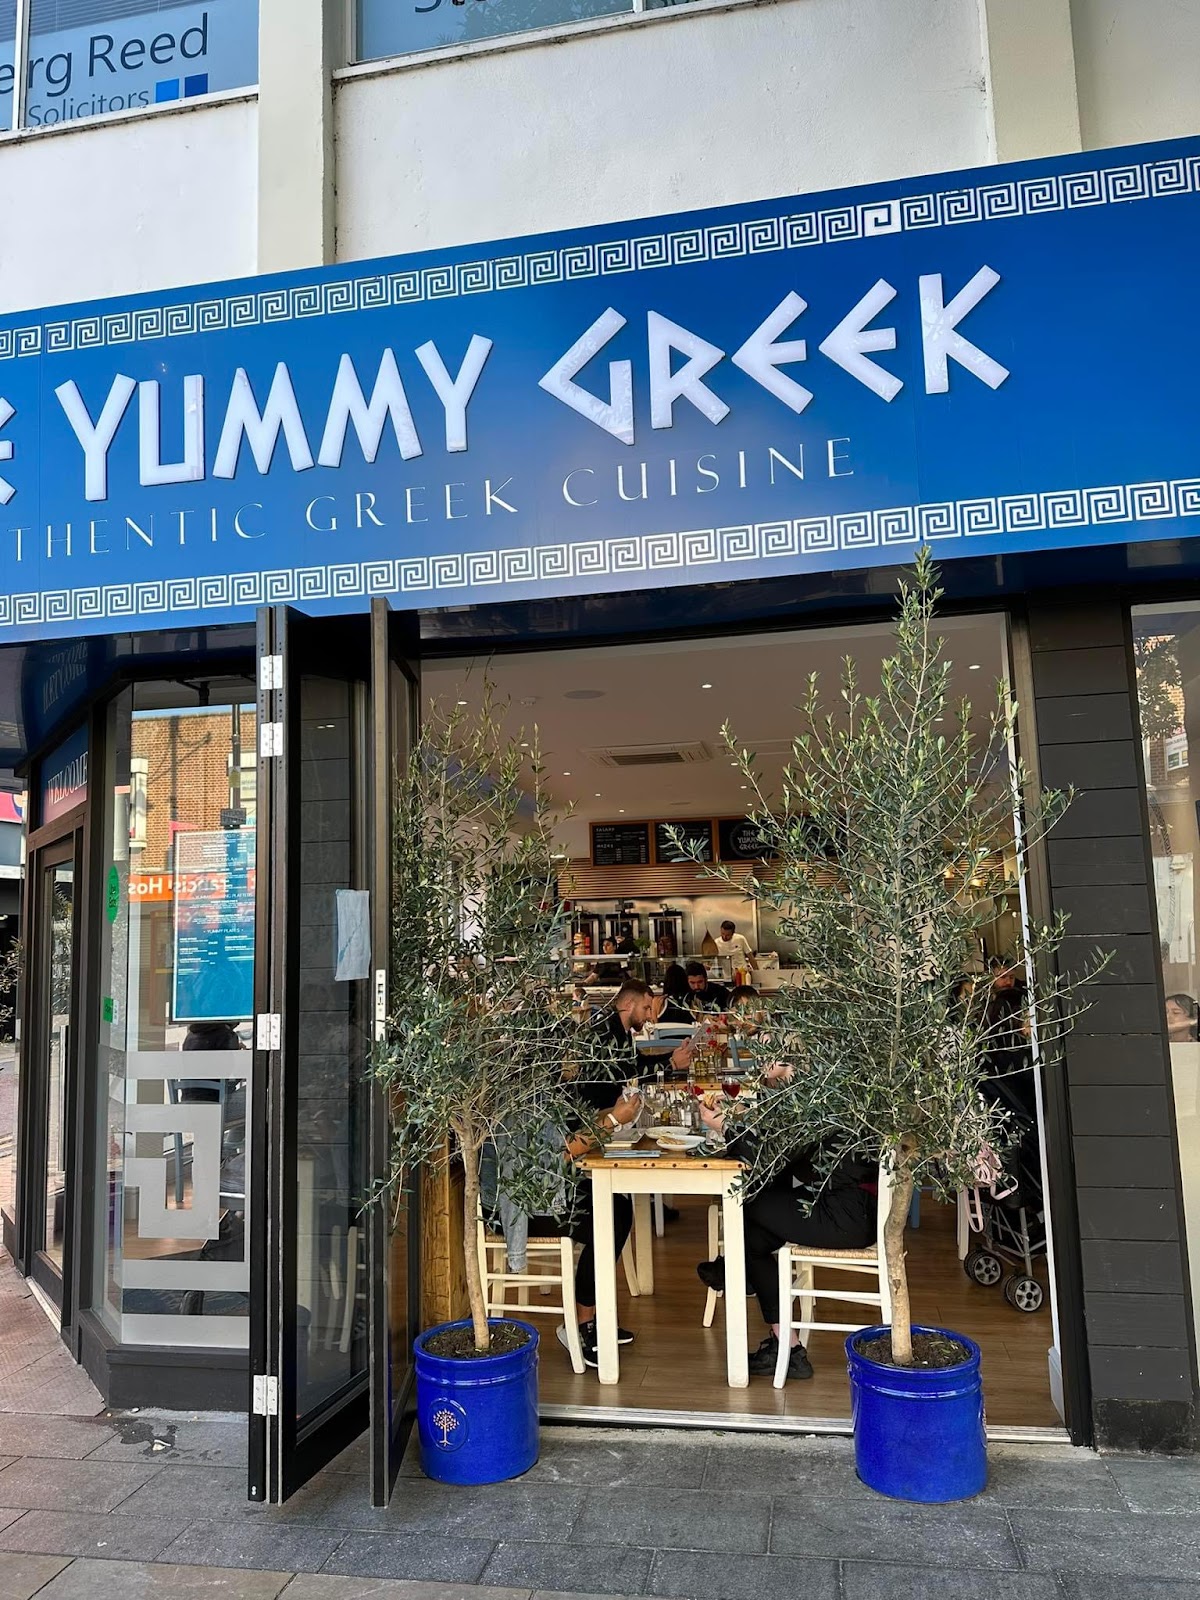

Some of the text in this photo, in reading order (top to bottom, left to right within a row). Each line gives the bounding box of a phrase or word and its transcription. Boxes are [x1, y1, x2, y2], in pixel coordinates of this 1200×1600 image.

[88, 12, 209, 77] Reed
[28, 90, 149, 127] Solicitors
[55, 334, 493, 502] YUMMY
[538, 264, 1011, 446] GREEK
[8, 437, 854, 562] THENTIC GREEK CUISINE
[48, 751, 88, 806] WELCOME
